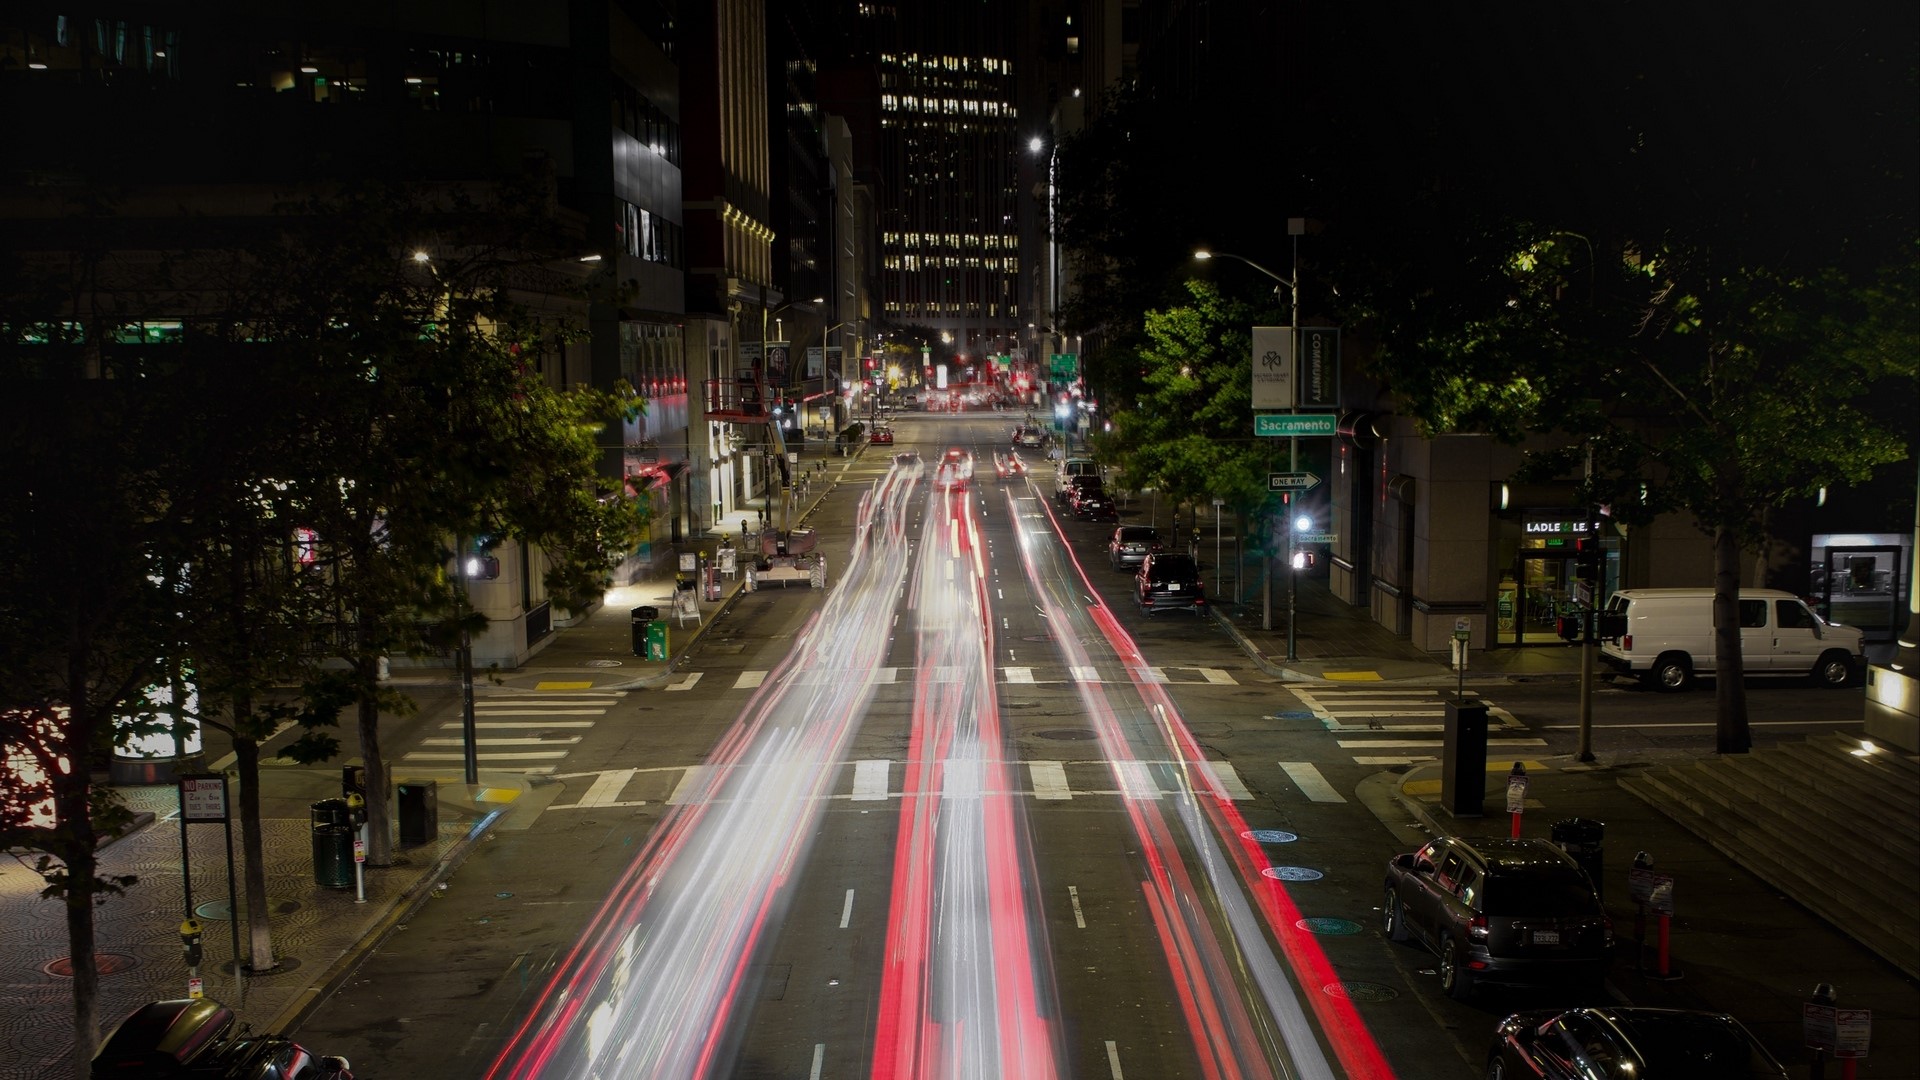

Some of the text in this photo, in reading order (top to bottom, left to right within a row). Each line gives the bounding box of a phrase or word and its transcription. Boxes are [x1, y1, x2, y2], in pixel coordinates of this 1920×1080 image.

[1312, 333, 1322, 402] COMMUNITY
[1260, 419, 1331, 431] Sacramento
[1526, 522, 1600, 532] LADLE LEF
[184, 780, 222, 791] NO PARKING
